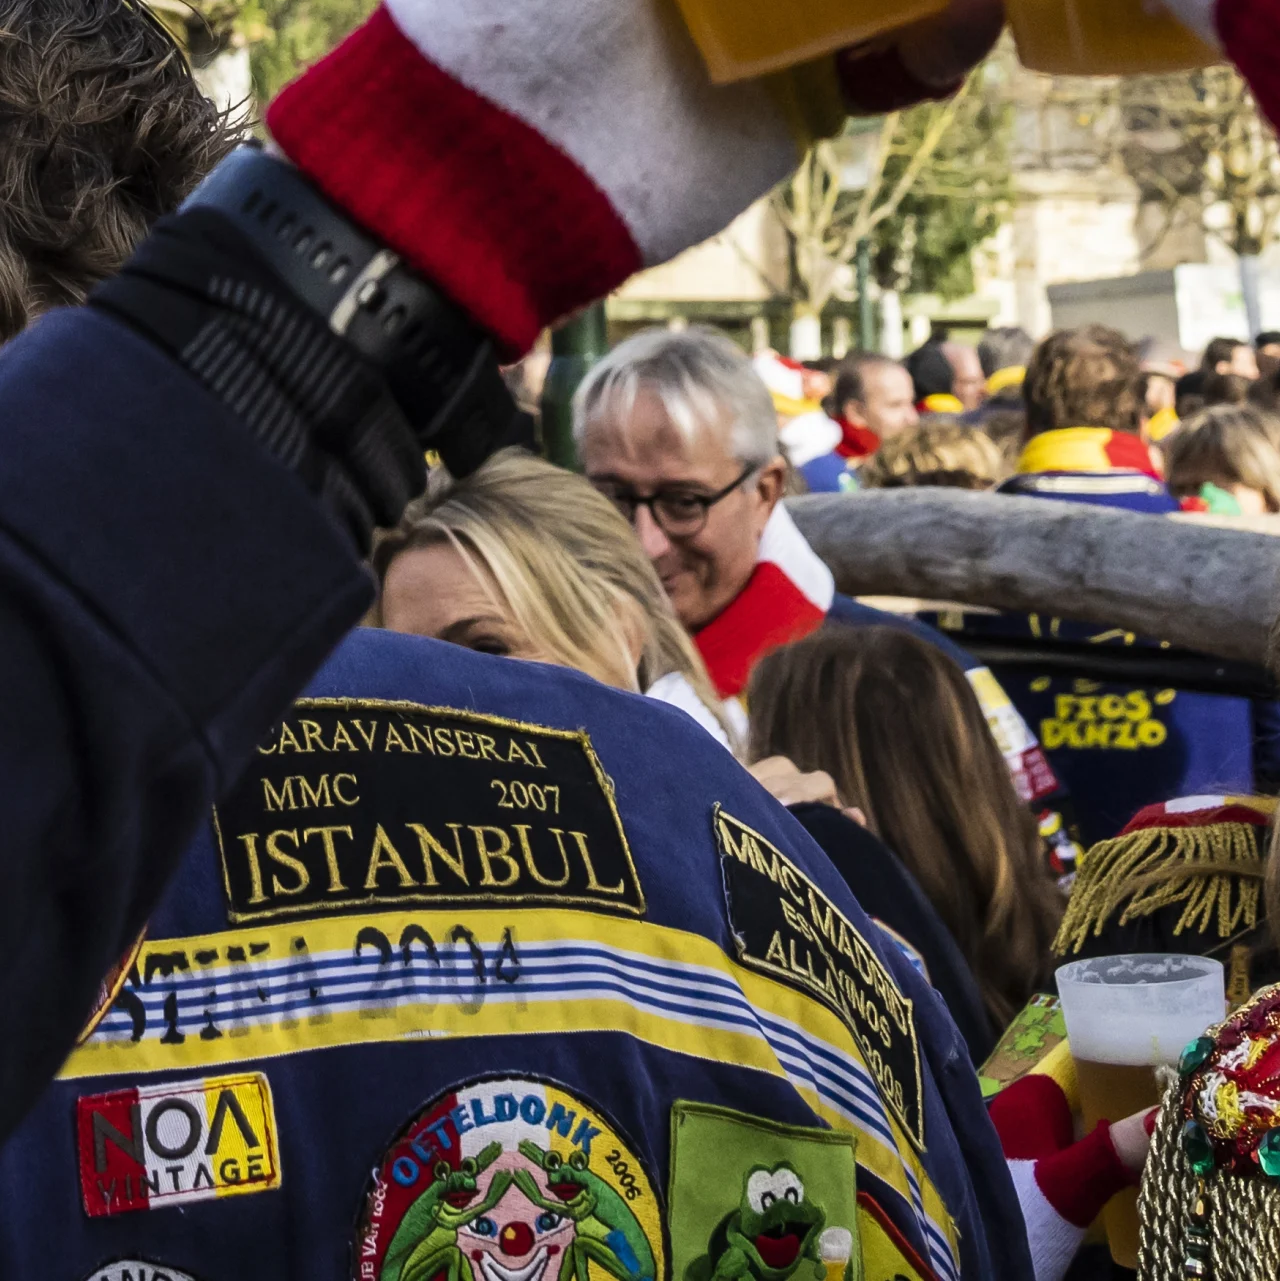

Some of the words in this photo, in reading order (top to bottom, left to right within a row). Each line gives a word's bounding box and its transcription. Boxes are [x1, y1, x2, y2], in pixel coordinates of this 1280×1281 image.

[261, 773, 360, 812] MMC
[491, 779, 560, 814] 2007
[237, 822, 625, 904] ISTANBUL
[719, 817, 804, 907] MMC
[807, 888, 908, 1036] MADRID
[354, 923, 528, 1019] 2004
[97, 1154, 265, 1202] VINTAGE
[392, 1093, 602, 1187] OETELDONK
[606, 1150, 642, 1201] 2006
